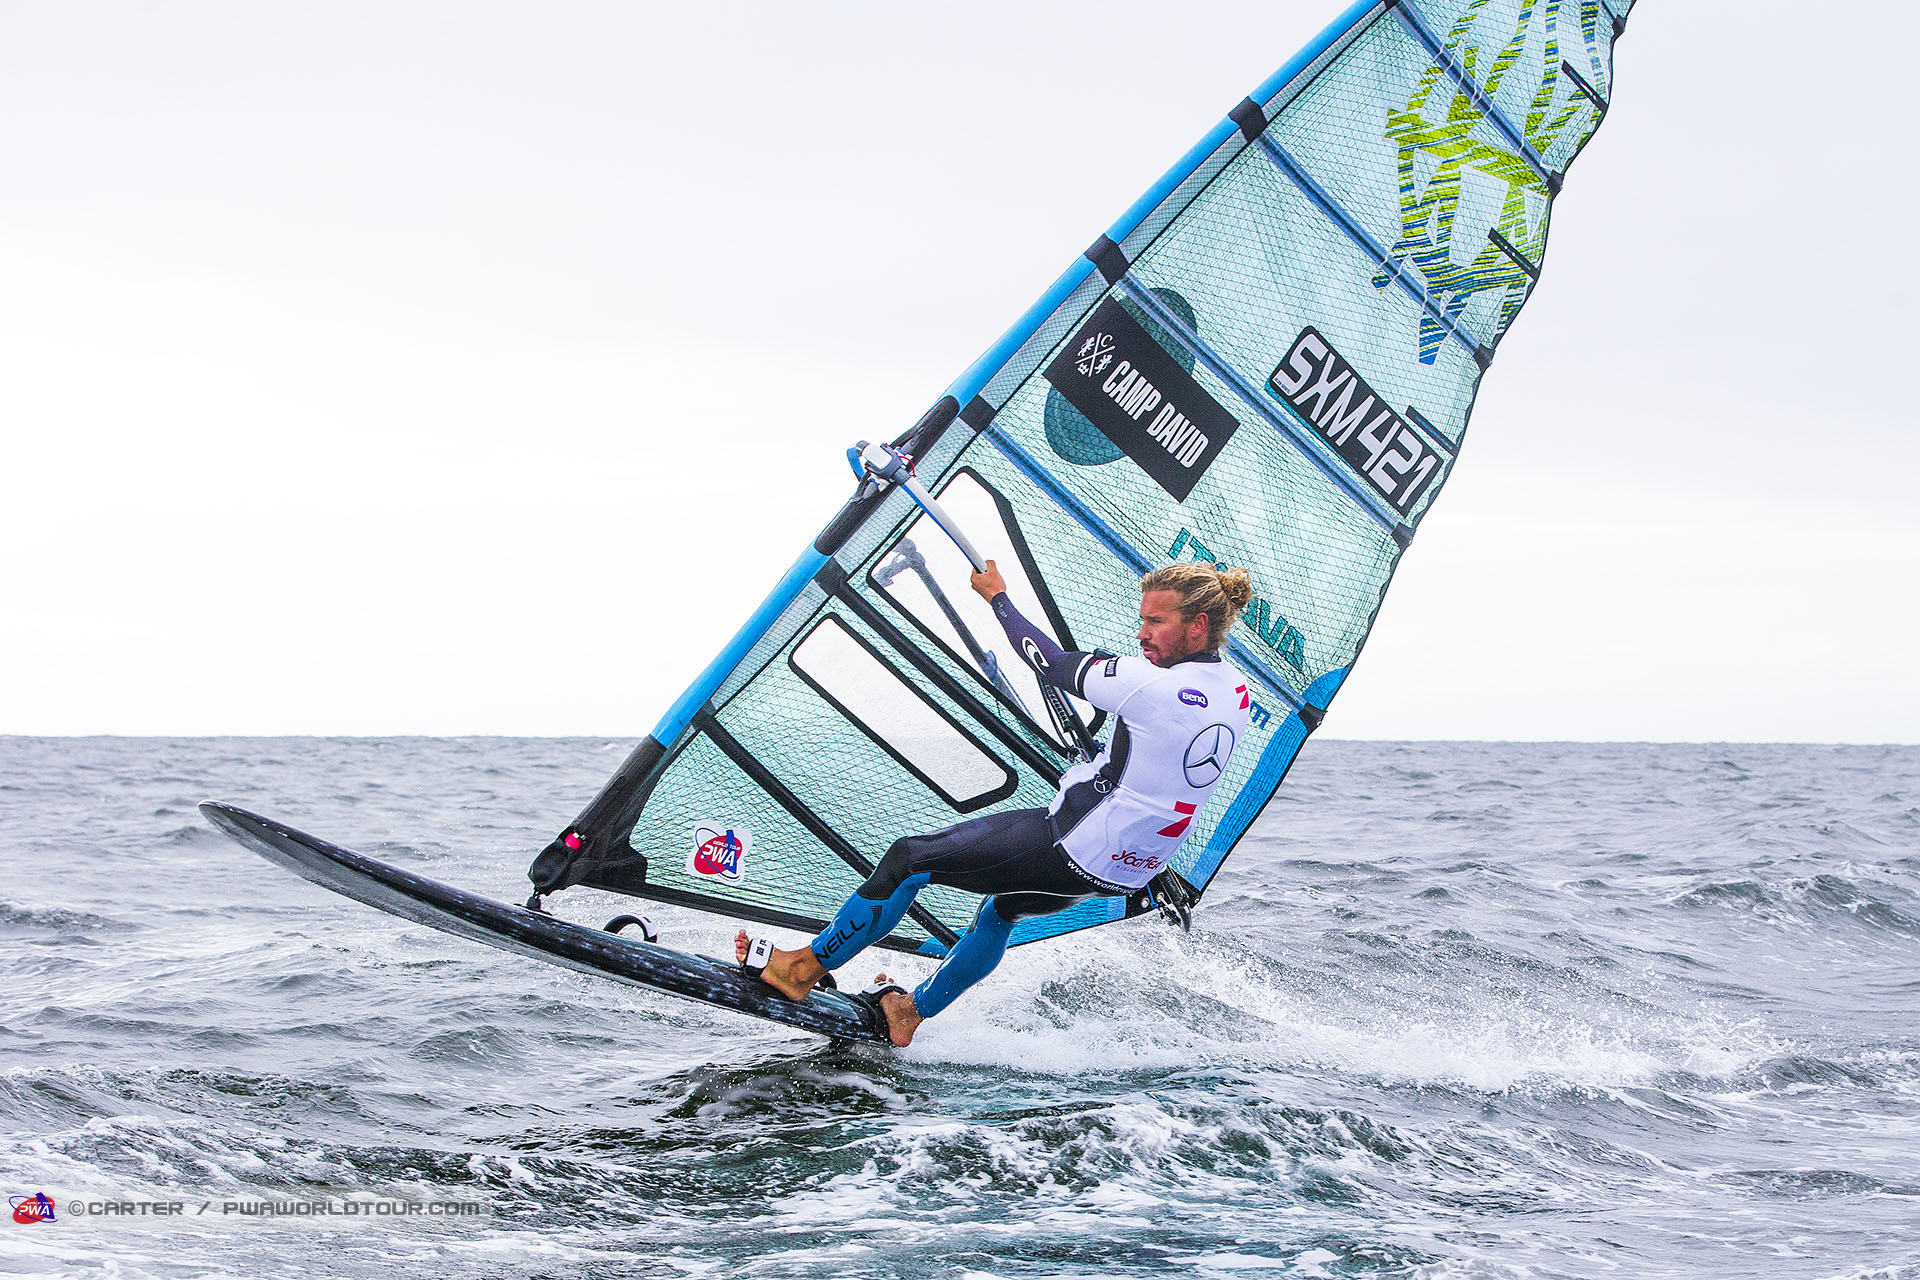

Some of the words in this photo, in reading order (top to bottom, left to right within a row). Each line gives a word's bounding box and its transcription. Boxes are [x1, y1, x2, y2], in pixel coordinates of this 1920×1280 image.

[1102, 360, 1162, 421] CAMP
[1146, 402, 1209, 468] DAVID
[700, 844, 736, 867] PWA
